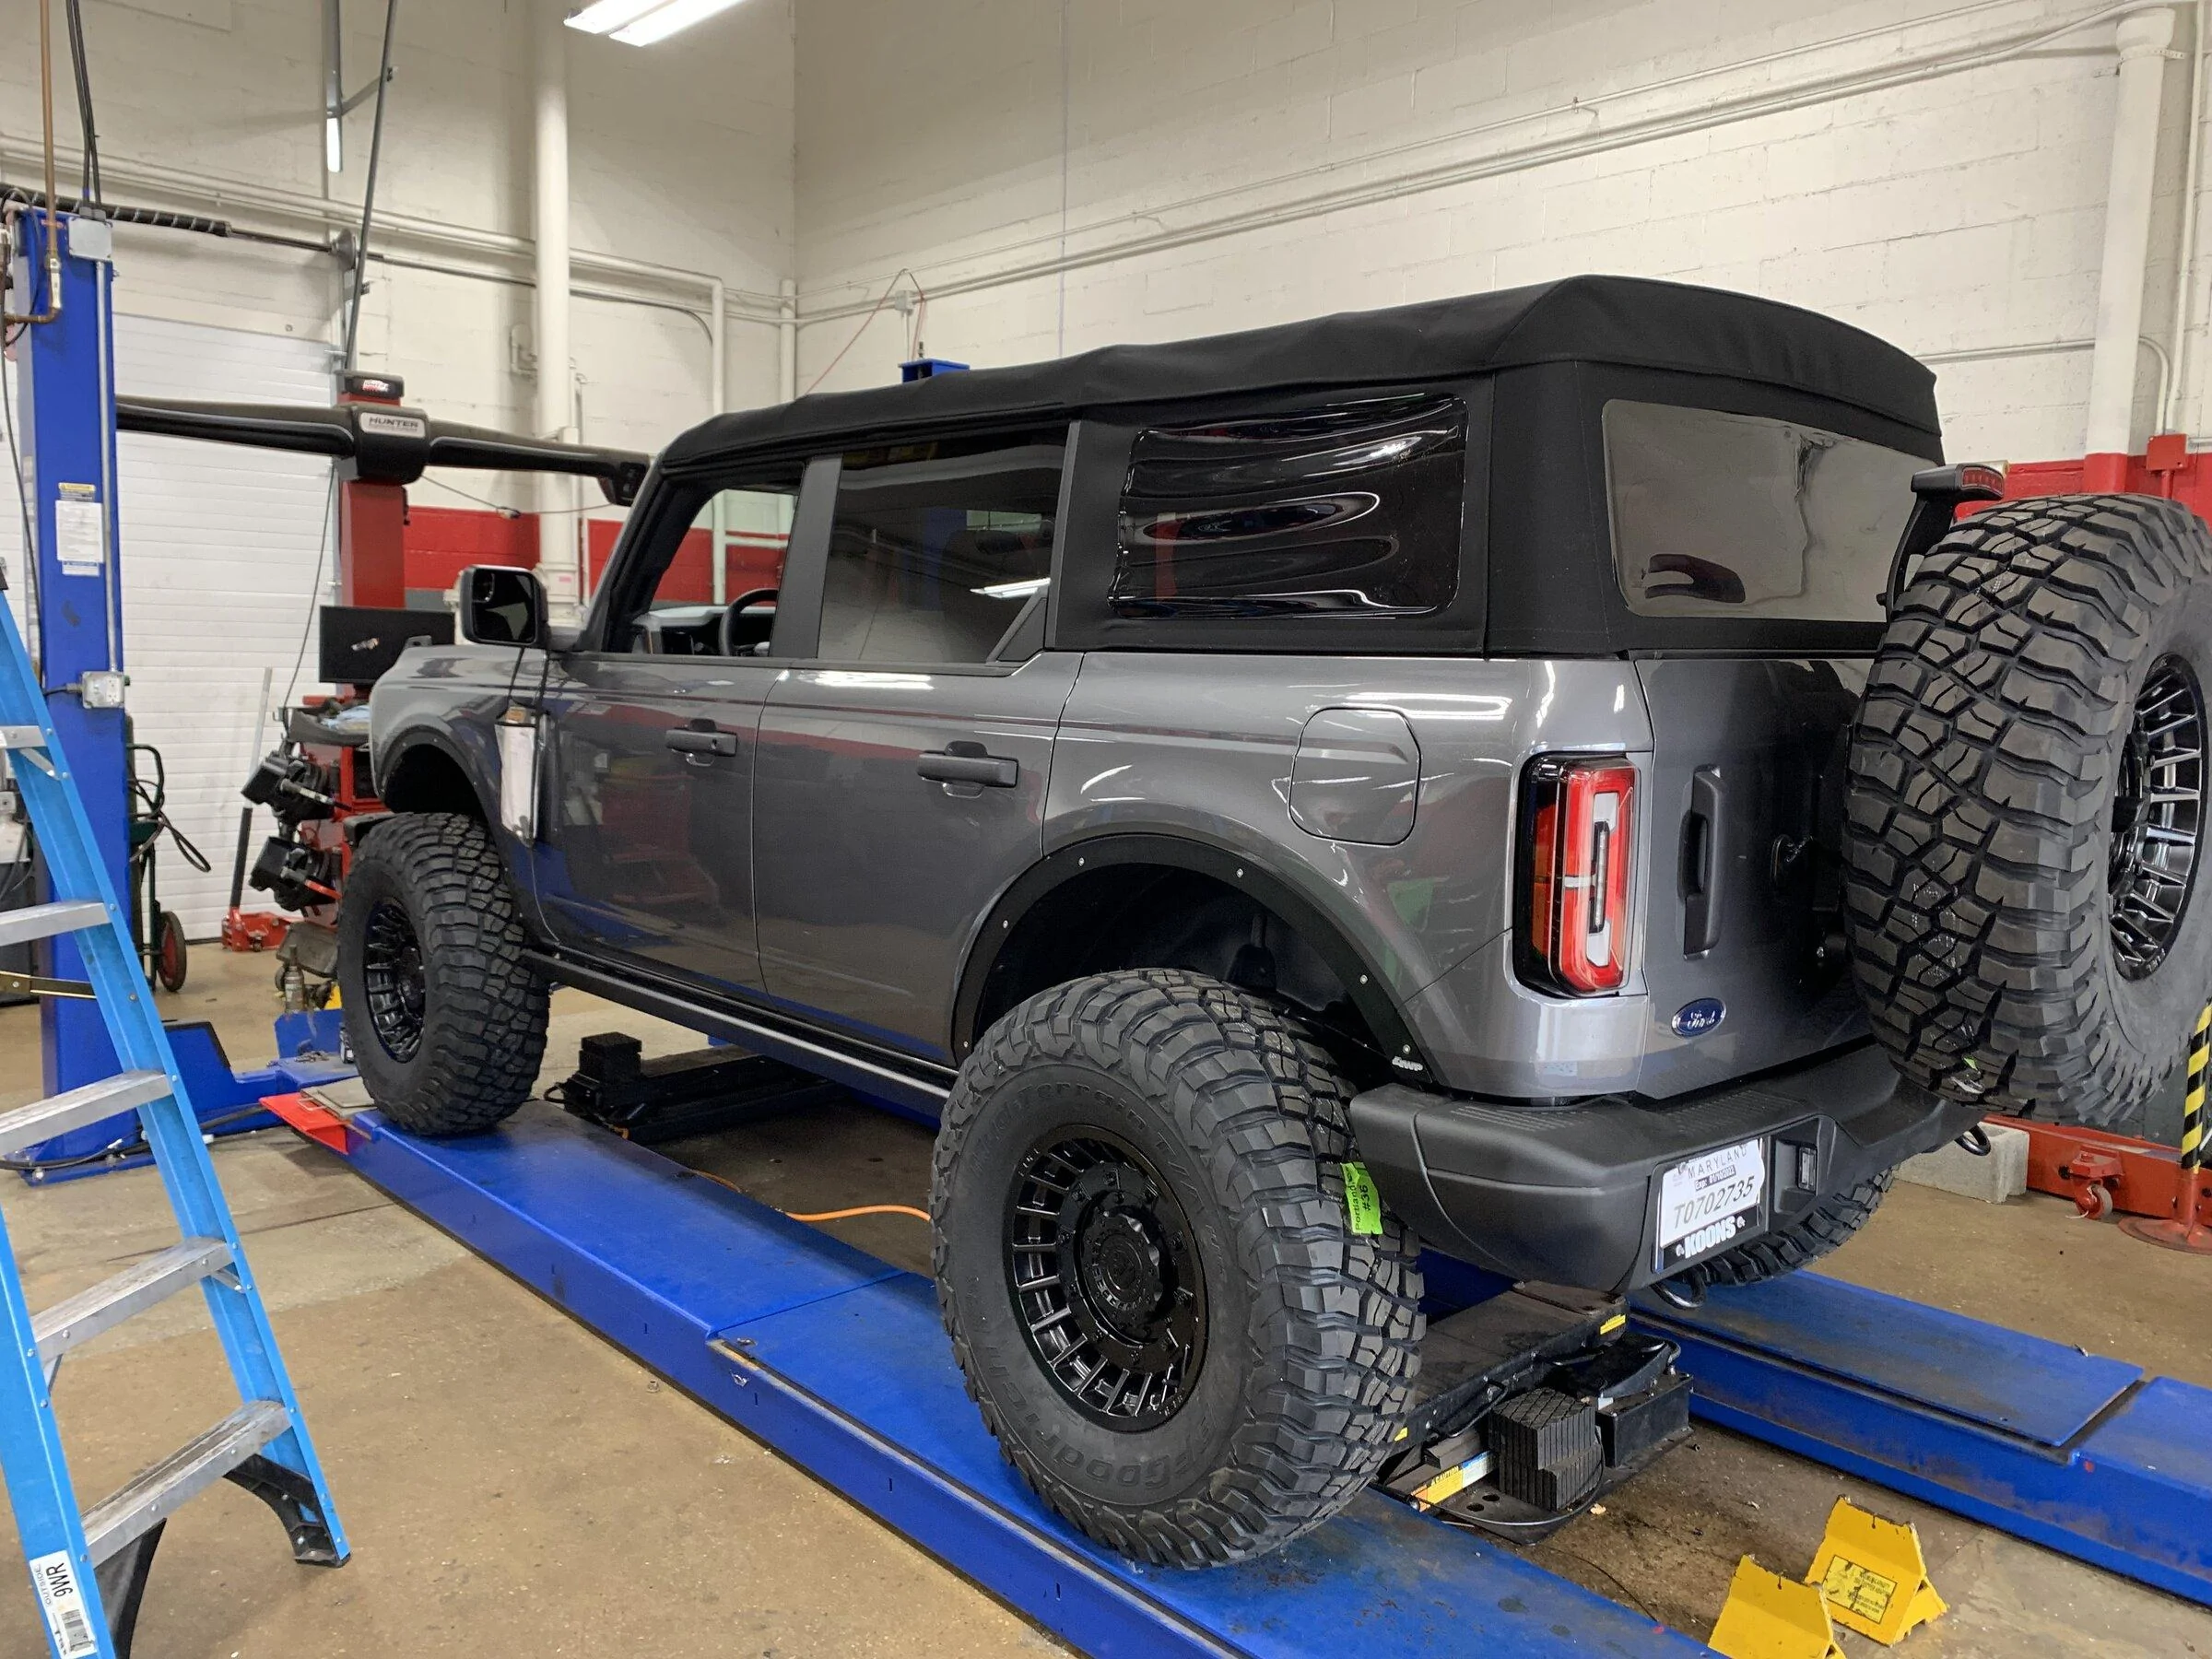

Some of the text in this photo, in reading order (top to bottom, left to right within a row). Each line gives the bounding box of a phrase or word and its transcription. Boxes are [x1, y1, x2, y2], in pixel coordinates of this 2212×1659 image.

[369, 416, 418, 428] HUNTER
[1687, 1009, 1717, 1030] Ford
[1688, 1143, 1748, 1180] MARYLAND
[1674, 1175, 1755, 1230] T0702735
[1684, 1215, 1736, 1259] KOONS
[1435, 1465, 1460, 1484] CAUTION
[34, 1564, 53, 1607] OUTSIDE
[45, 1562, 74, 1598] 9WR
